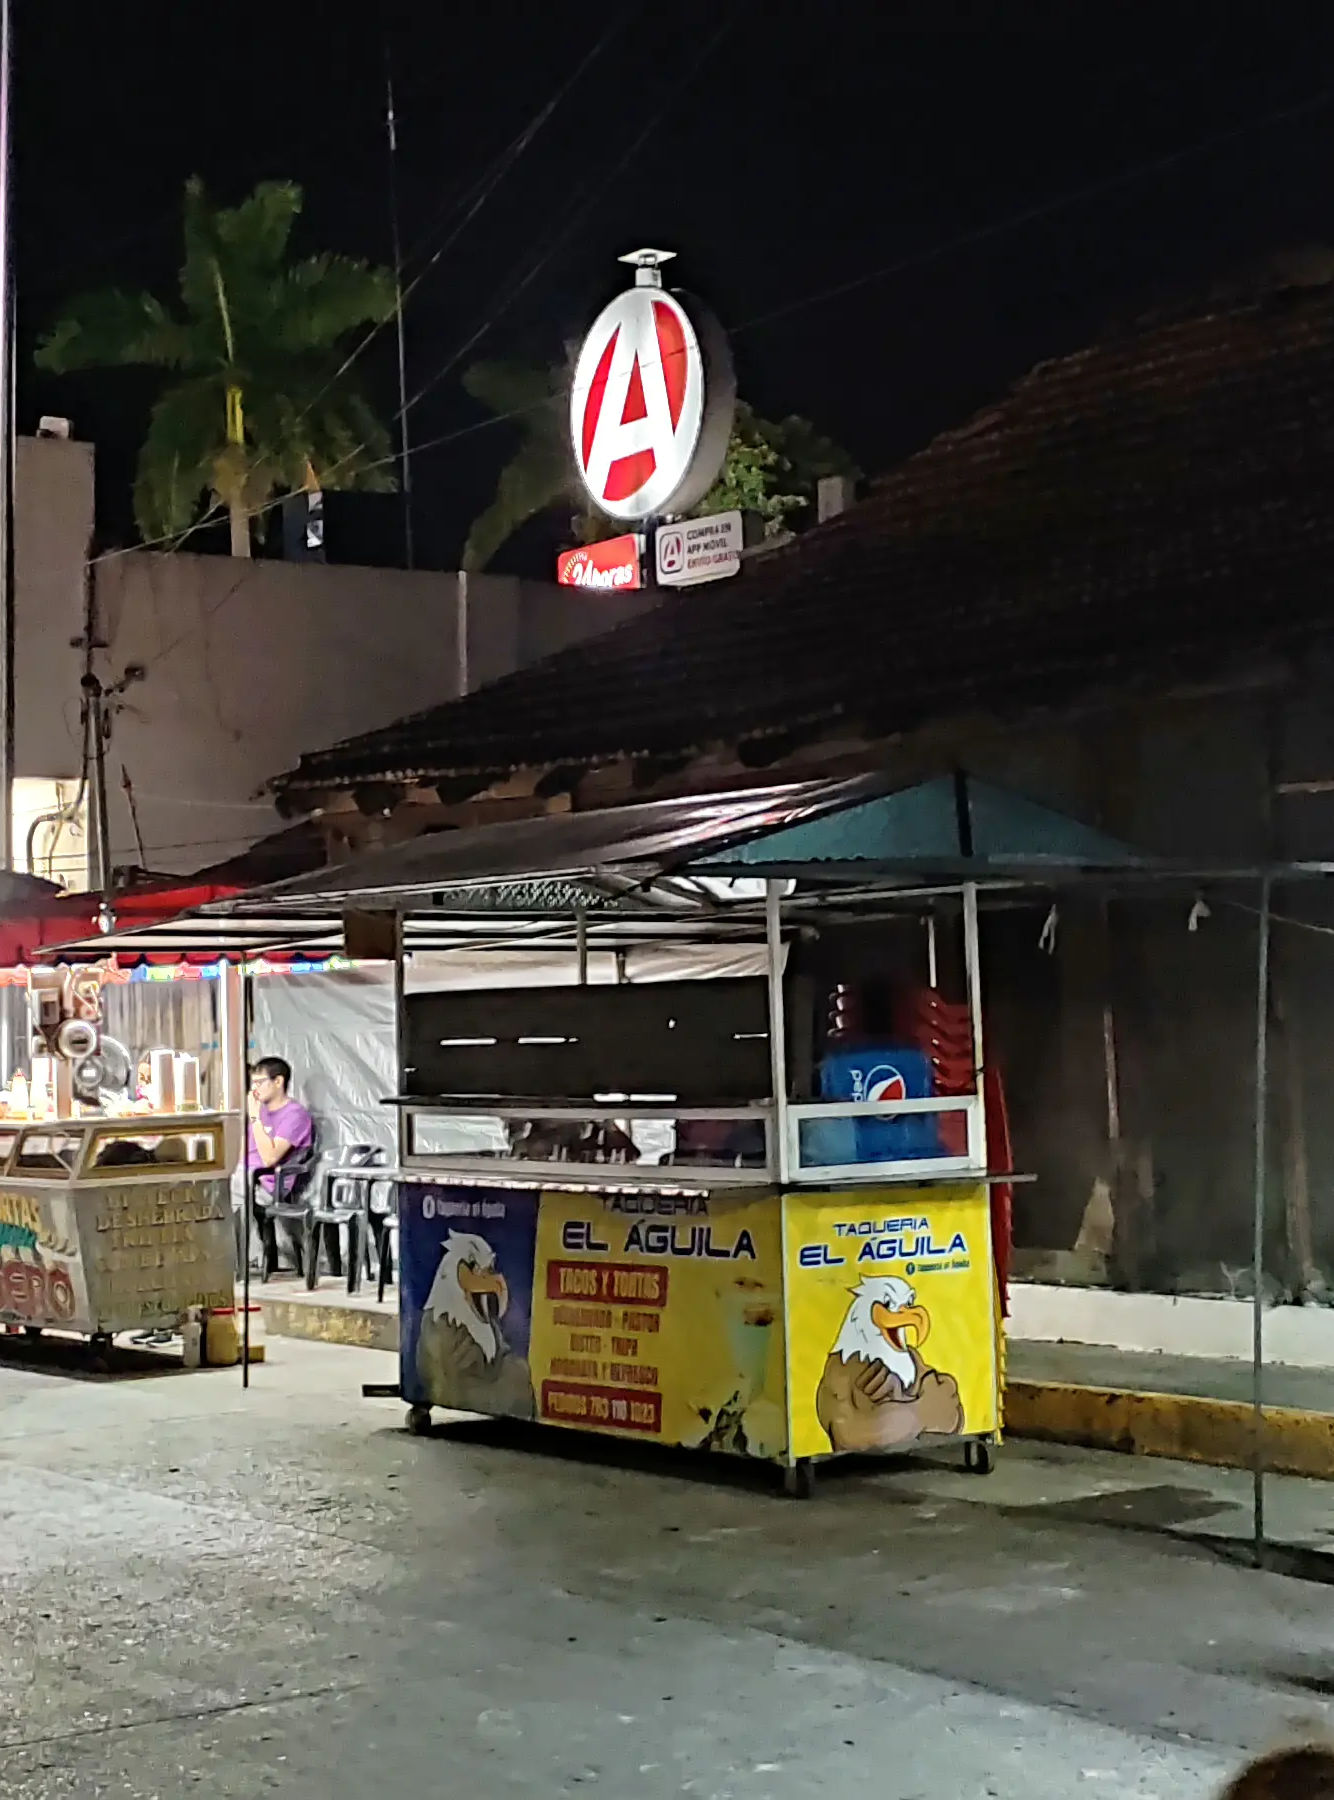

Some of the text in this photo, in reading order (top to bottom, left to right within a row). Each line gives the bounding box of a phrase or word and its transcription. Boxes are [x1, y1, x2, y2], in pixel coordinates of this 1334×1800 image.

[579, 292, 692, 508] A
[563, 1218, 757, 1260] EL ÁGUILA
[834, 1217, 929, 1237] TAQUERIA
[800, 1233, 967, 1267] EL ÁGUILA
[559, 1266, 661, 1300] TACOS Y TORTAS
